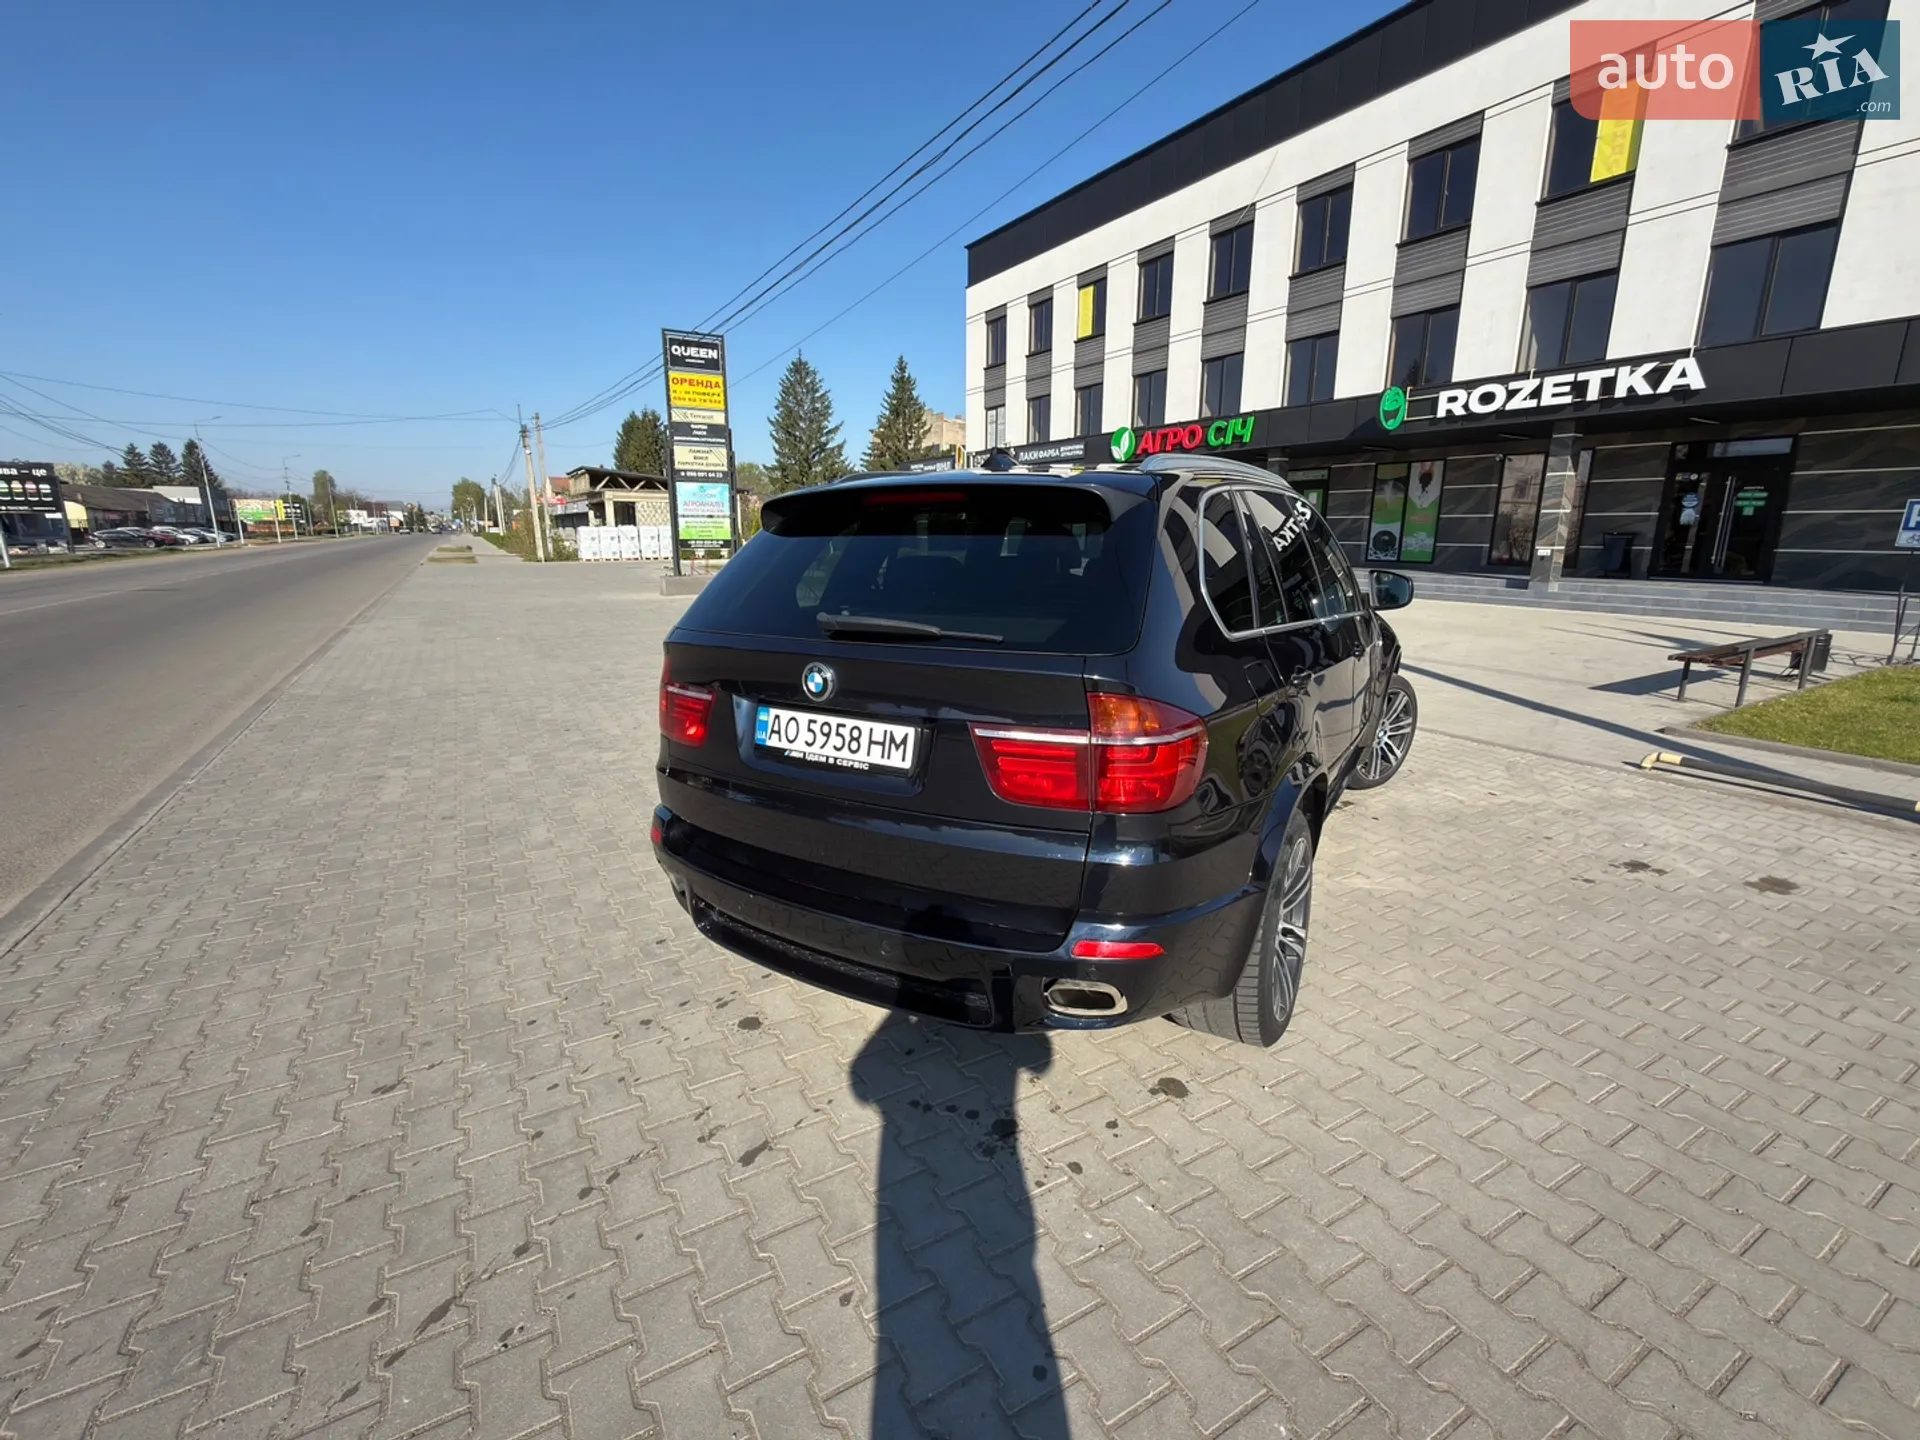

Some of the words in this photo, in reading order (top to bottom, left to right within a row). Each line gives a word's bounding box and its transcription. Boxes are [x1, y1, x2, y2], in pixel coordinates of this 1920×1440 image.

[671, 345, 718, 359] QUEEN
[671, 377, 721, 389] ОРЕНДА
[1436, 358, 1705, 418] ROZETKA
[1136, 424, 1203, 454] АГРО
[1207, 416, 1255, 447] СІЧ
[757, 730, 767, 739] UA
[768, 714, 799, 744] AO
[805, 719, 862, 754] 5958
[836, 758, 869, 770] СЕРВІС
